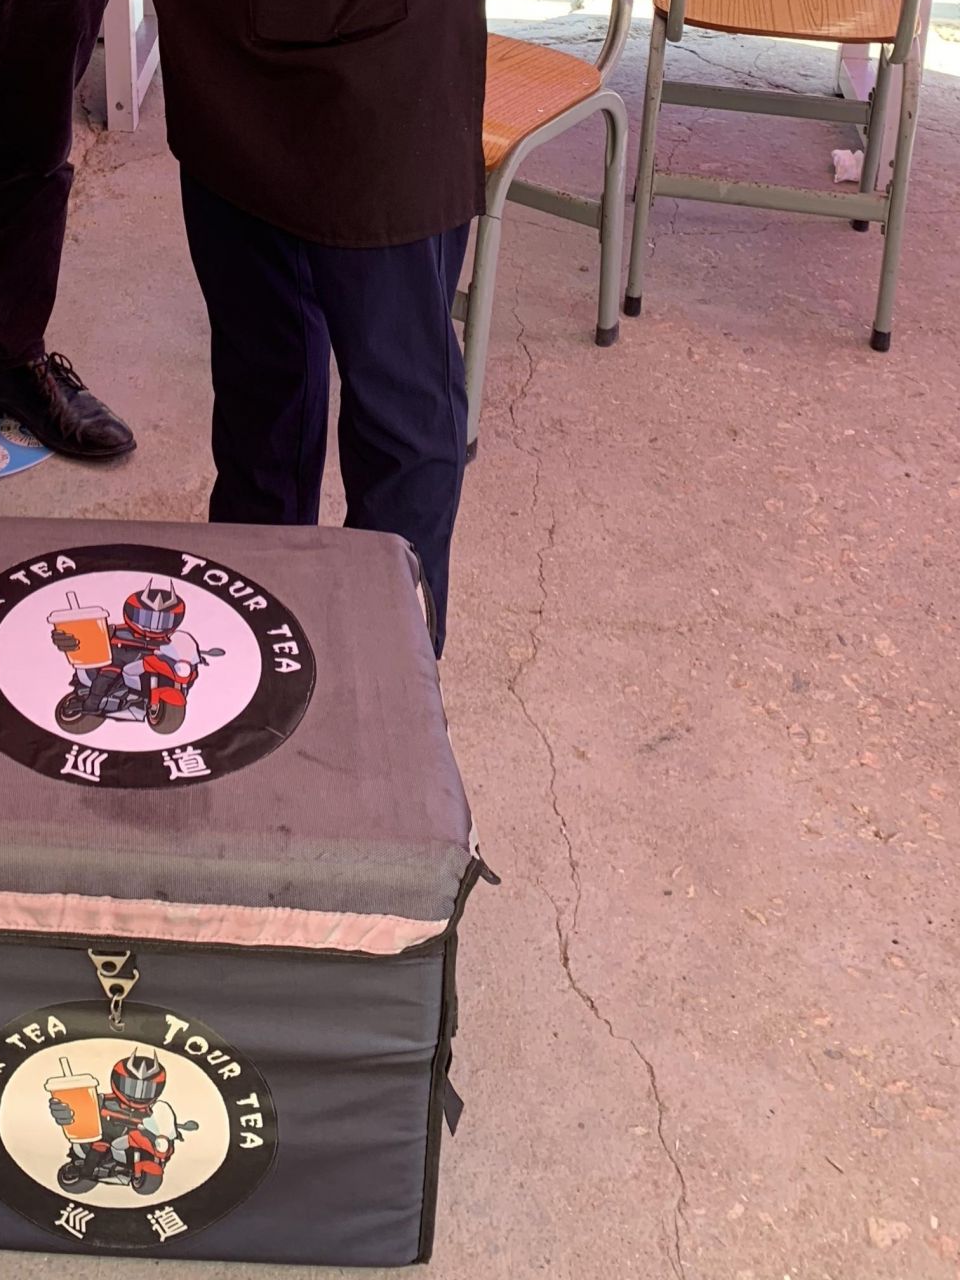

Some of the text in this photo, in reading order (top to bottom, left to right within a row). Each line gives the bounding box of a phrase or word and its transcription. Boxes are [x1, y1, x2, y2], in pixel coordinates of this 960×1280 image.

[10, 555, 76, 586] TEA
[181, 553, 302, 673] TOUR TEA
[5, 1015, 67, 1049] TEA
[163, 1014, 264, 1149] TOUR TEA
